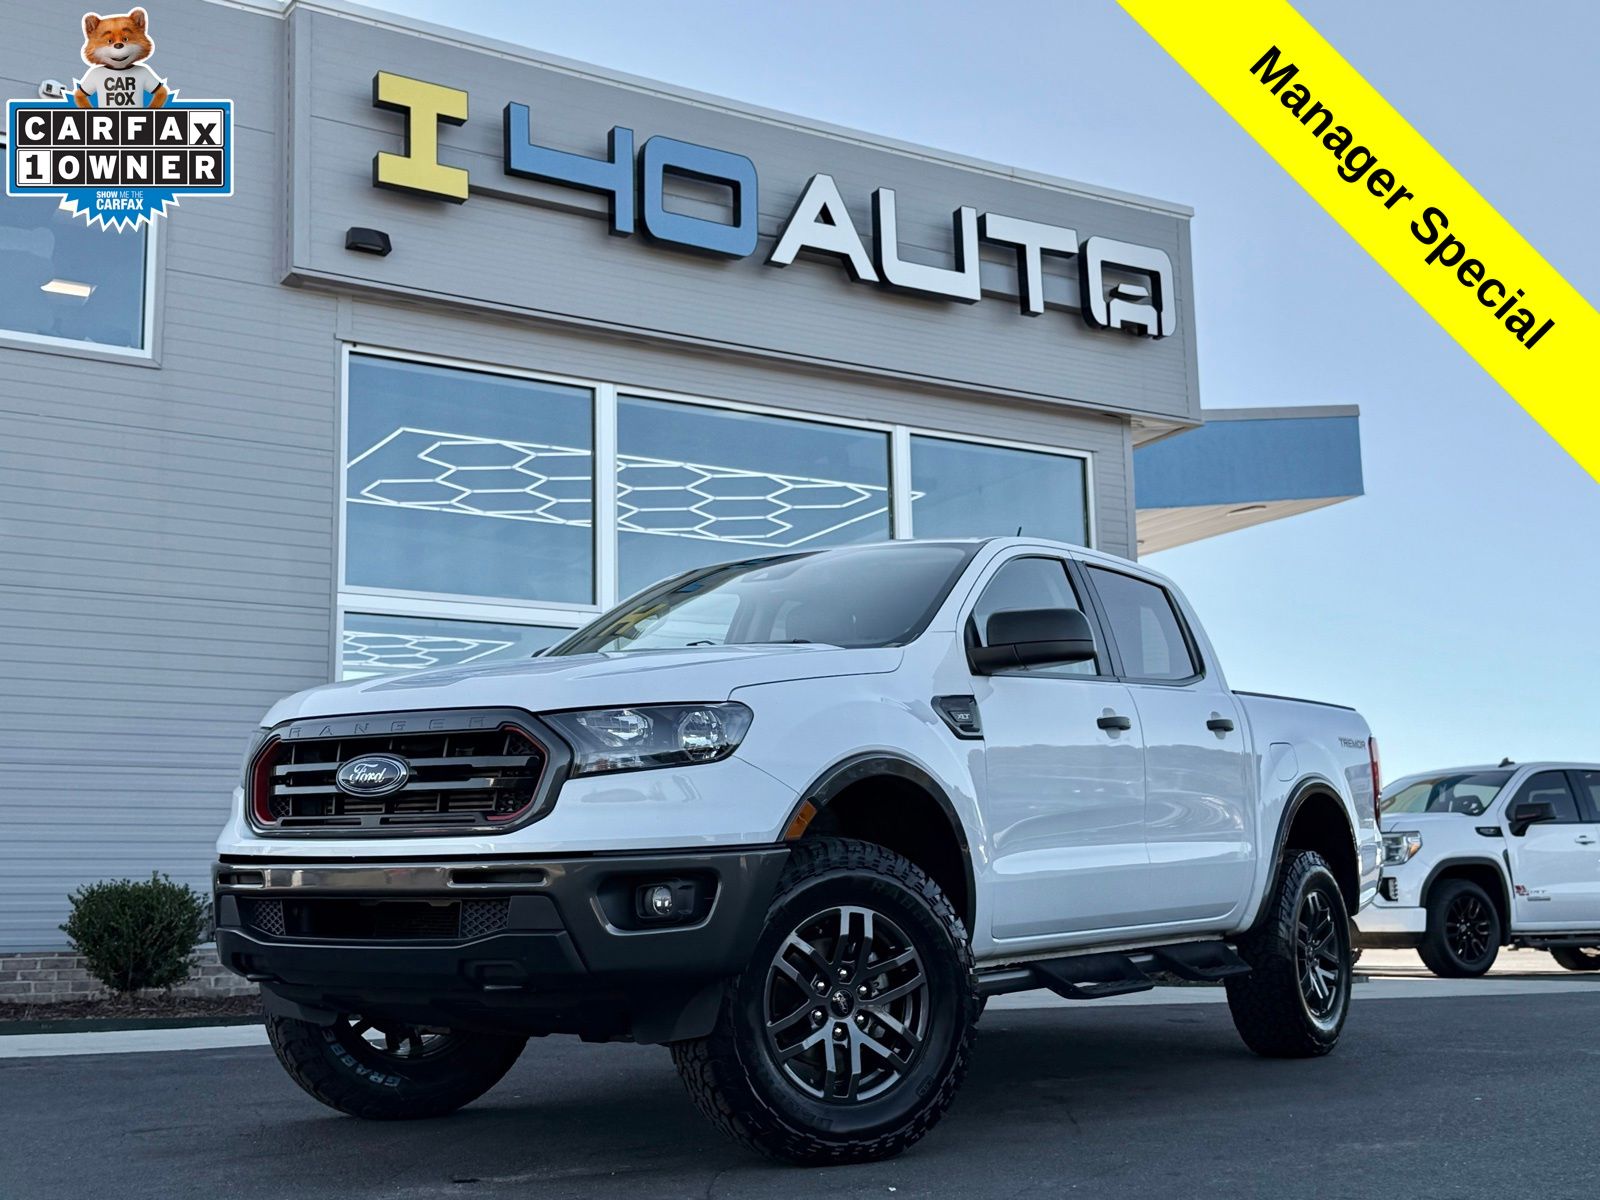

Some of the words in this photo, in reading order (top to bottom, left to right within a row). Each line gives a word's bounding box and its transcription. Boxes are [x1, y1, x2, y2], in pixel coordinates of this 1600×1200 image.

[765, 173, 1177, 340] AUTO
[289, 716, 487, 738] RANGER
[350, 763, 387, 784] Ford
[321, 1029, 401, 1088] GRABBE
